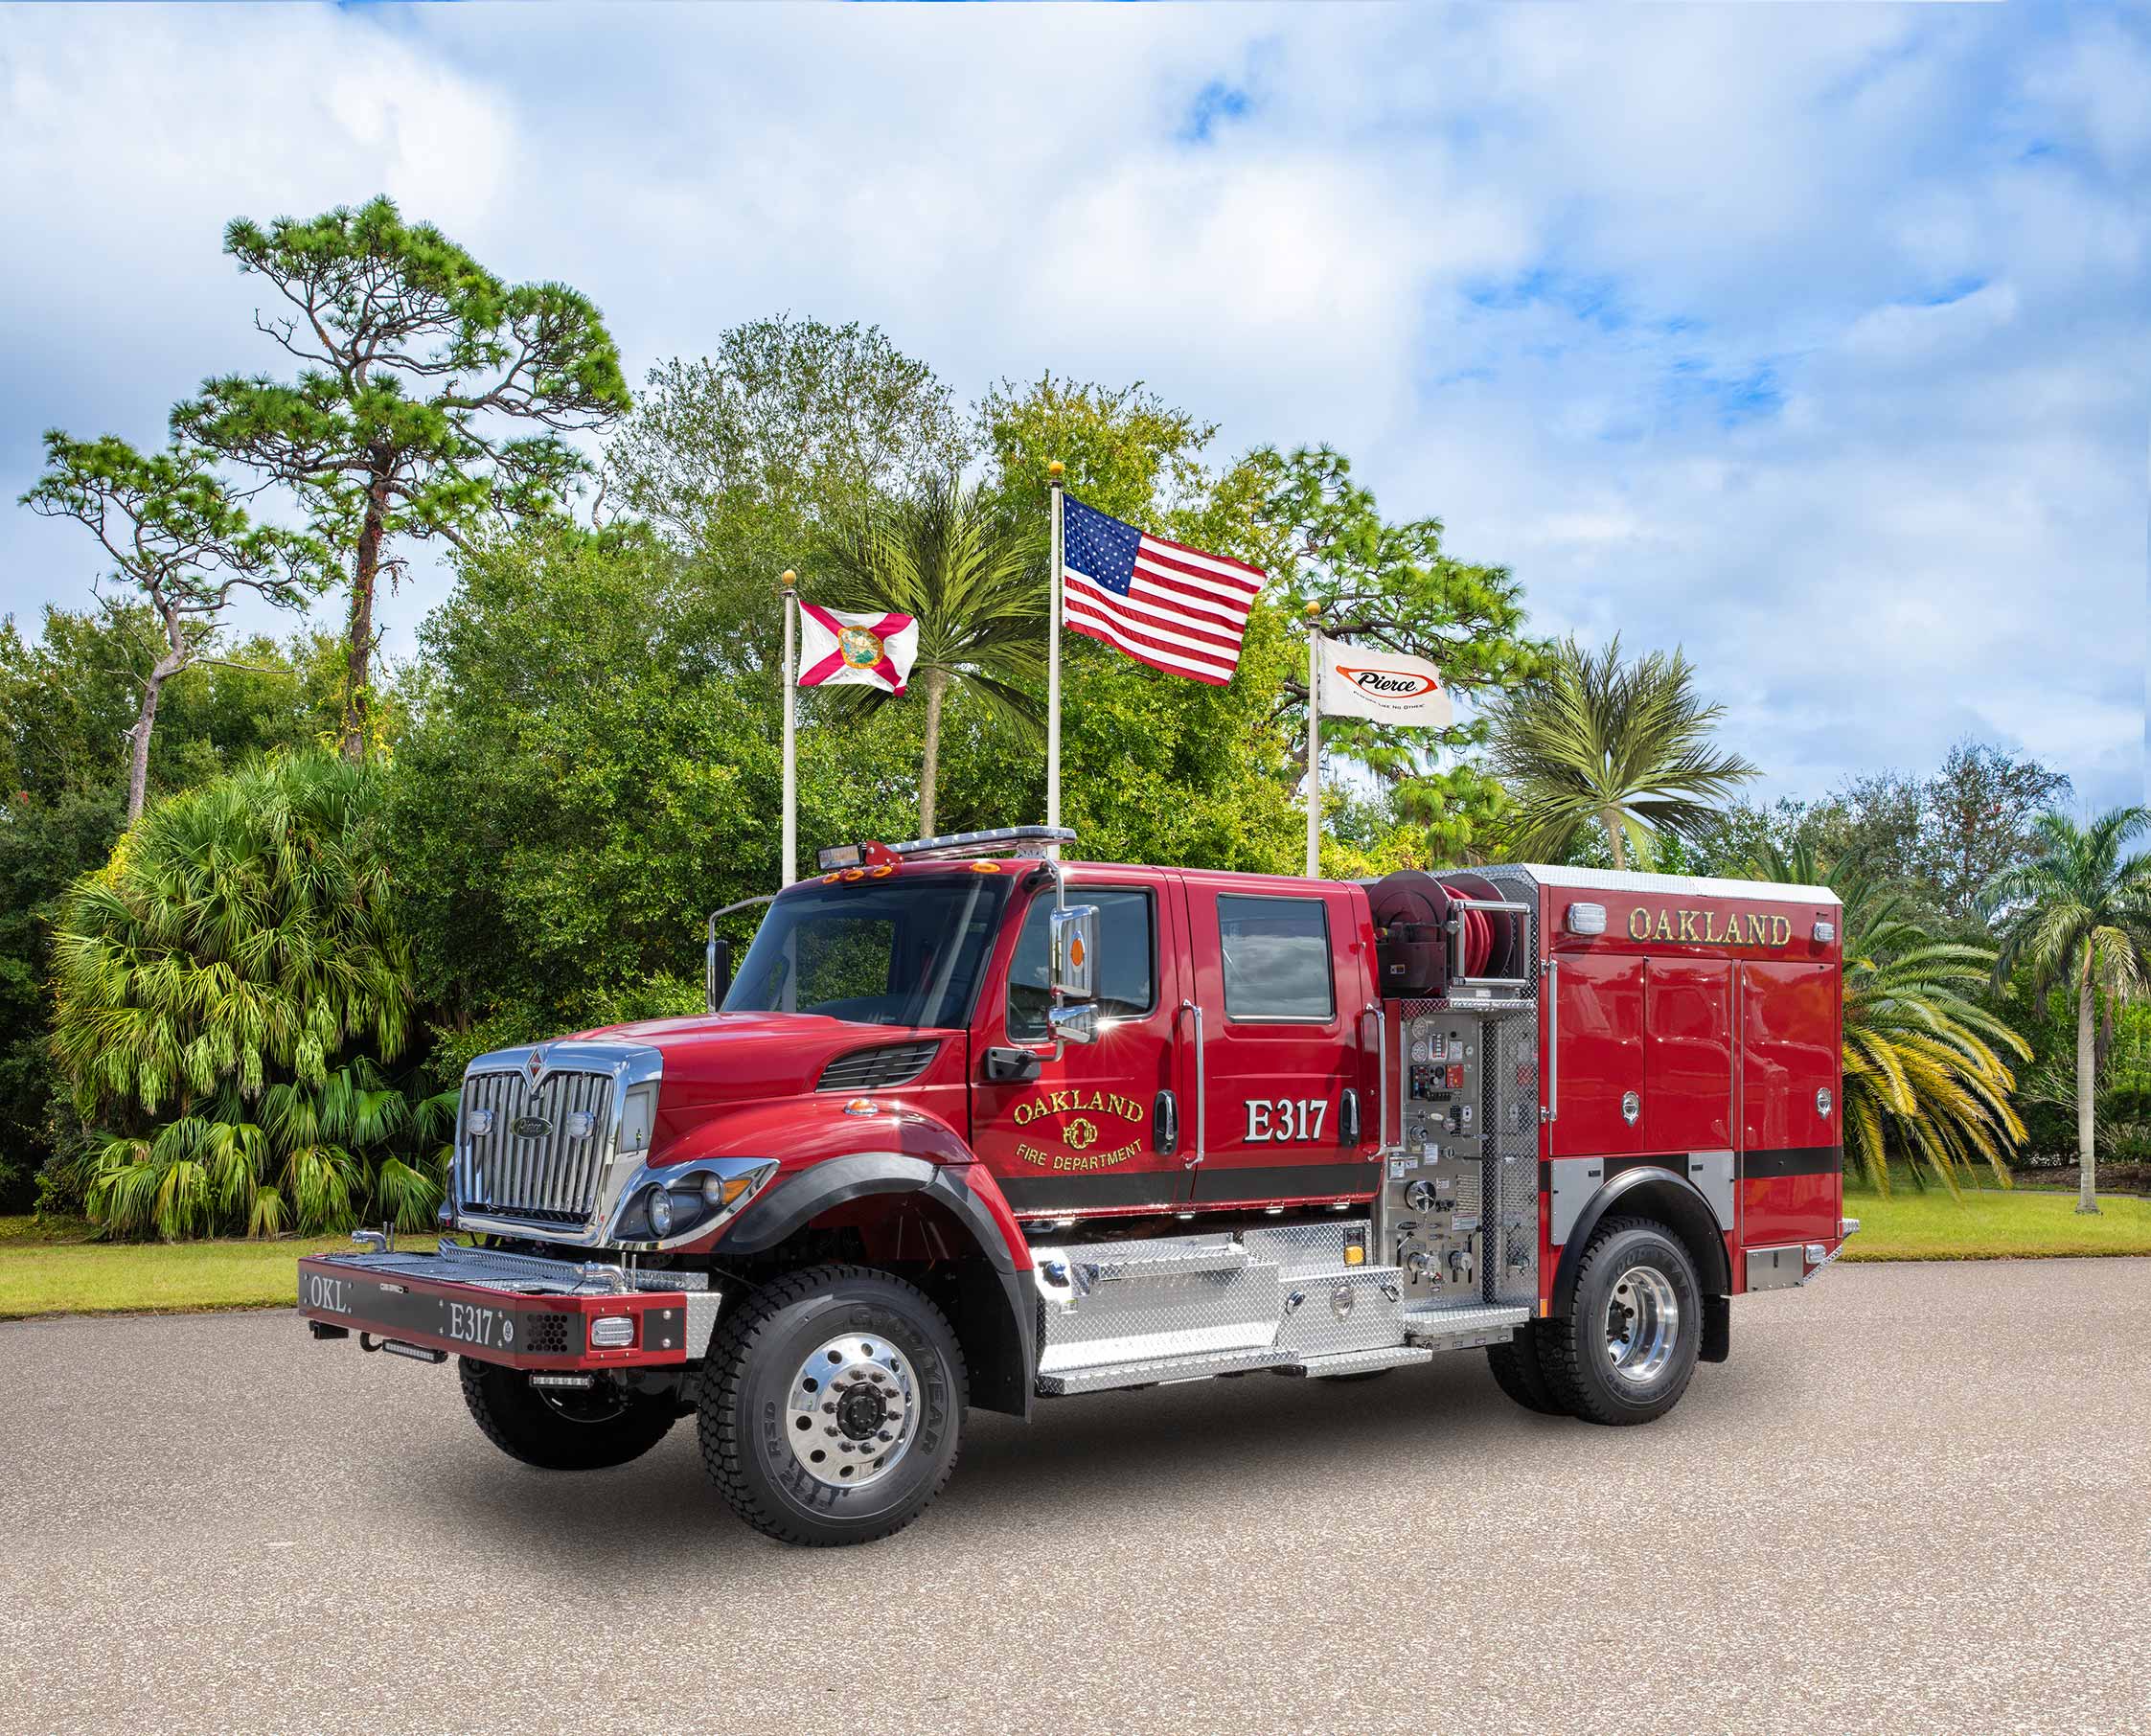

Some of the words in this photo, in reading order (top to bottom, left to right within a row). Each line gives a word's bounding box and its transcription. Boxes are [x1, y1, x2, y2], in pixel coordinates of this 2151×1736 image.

[1358, 672, 1416, 692] Pierce
[1628, 906, 1792, 946] OAKLAND
[1014, 1089, 1144, 1126] OAKLAND
[1243, 1099, 1328, 1141] E317
[1016, 1143, 1048, 1166] FIRE
[1052, 1138, 1142, 1171] DEPARTMENT
[309, 1275, 347, 1312] OKL
[449, 1302, 493, 1346] E317
